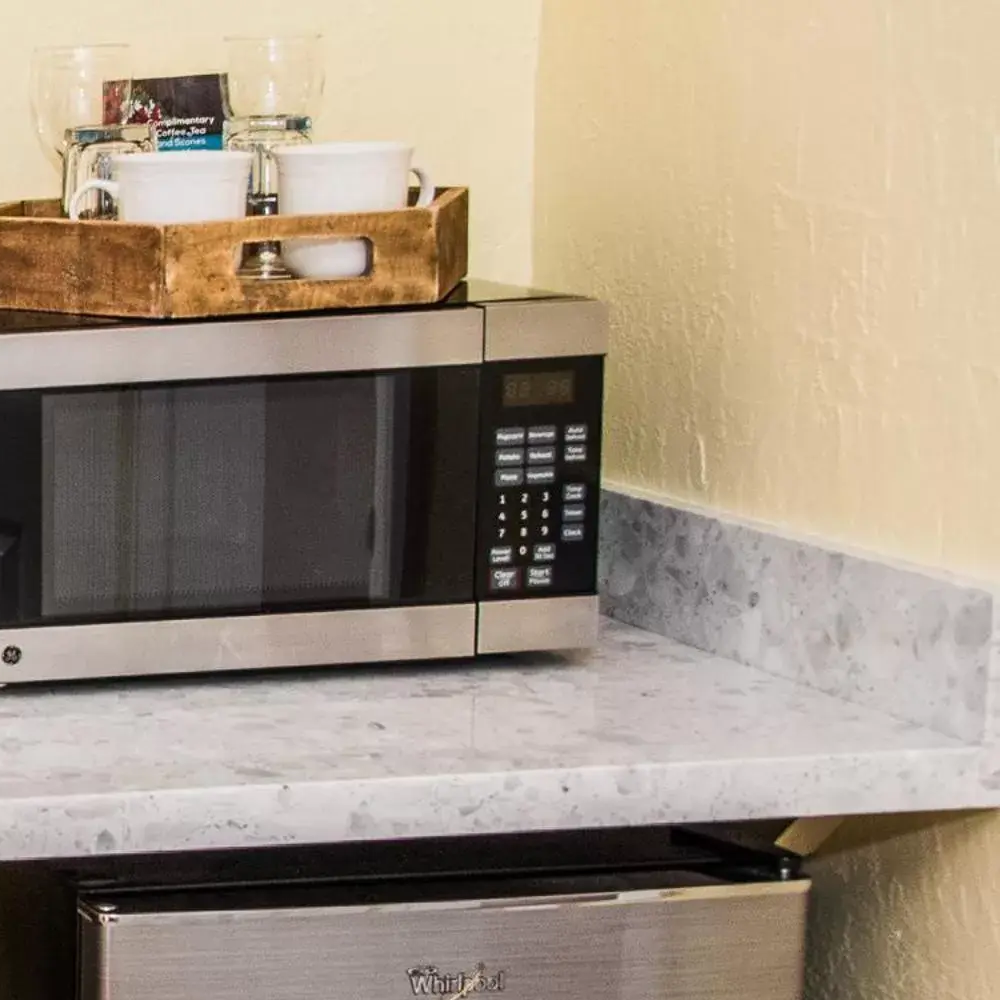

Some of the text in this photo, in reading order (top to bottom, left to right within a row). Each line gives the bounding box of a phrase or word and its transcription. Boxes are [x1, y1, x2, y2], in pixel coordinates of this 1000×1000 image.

[148, 116, 215, 127] Complimentary
[191, 126, 207, 135] Tea
[174, 138, 206, 147] Scones
[499, 491, 549, 505] 1 2 3
[498, 508, 549, 521] 4 5 6
[499, 525, 549, 539] 7 8 9
[519, 545, 528, 556] 0
